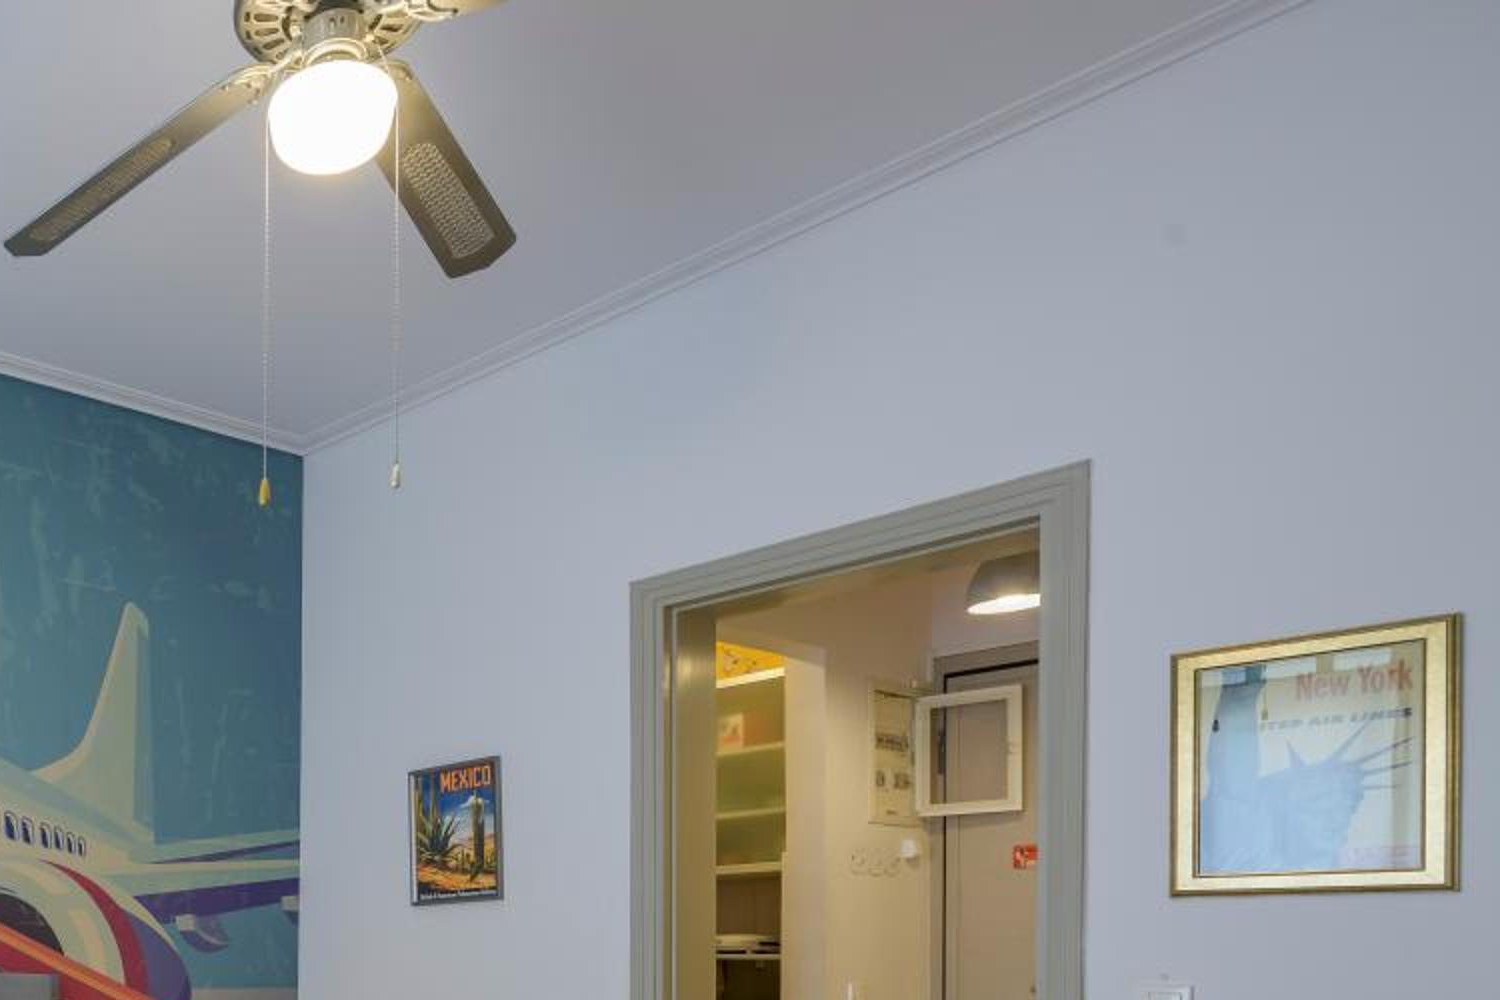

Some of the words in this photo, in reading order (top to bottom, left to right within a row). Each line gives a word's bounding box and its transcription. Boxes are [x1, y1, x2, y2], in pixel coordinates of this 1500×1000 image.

[1295, 673, 1349, 705] New
[1357, 659, 1413, 694] York
[440, 766, 491, 793] MEXICO
